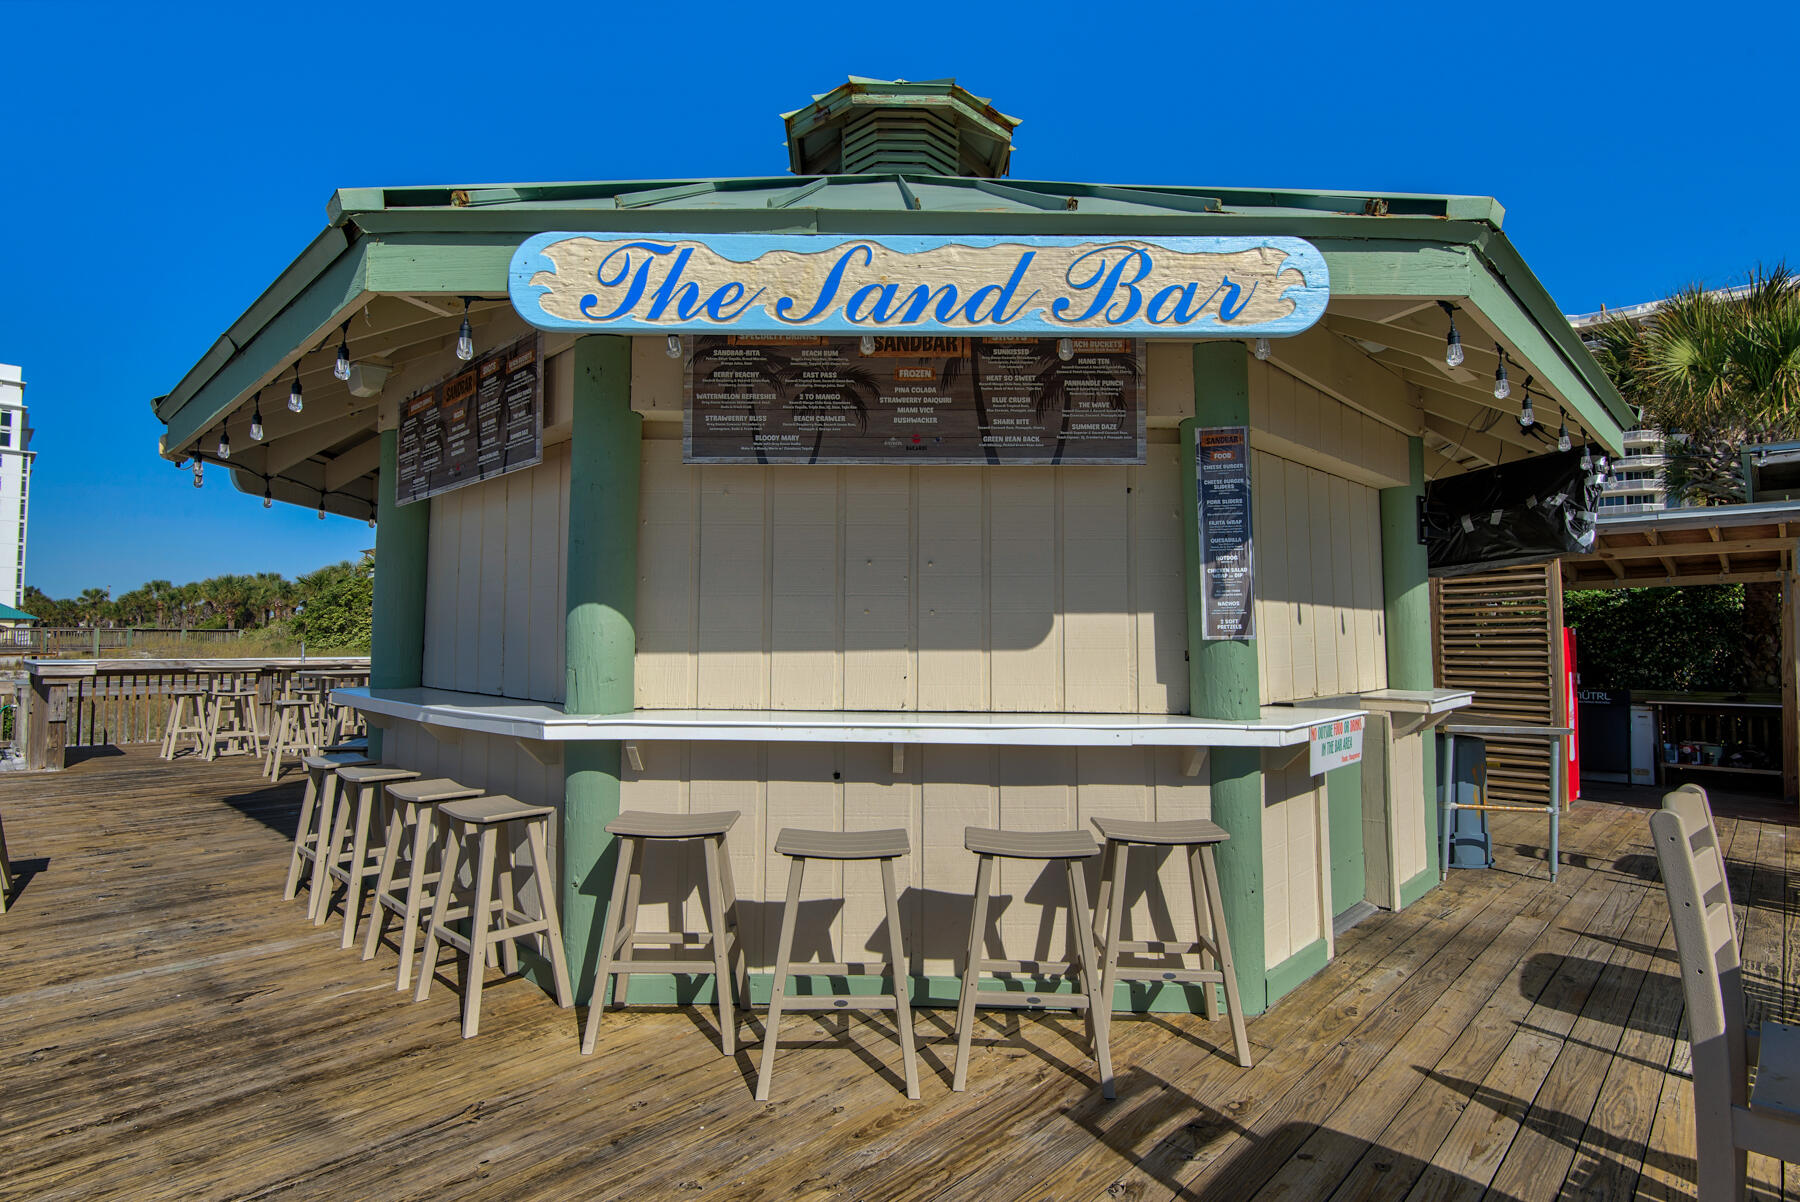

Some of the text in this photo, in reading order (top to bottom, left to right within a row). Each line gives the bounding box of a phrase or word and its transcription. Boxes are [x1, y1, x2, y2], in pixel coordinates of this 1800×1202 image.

[580, 242, 1258, 324] The Sand Bar
[873, 336, 958, 352] SANDBAR
[1090, 340, 1122, 348] BUCKETS
[899, 369, 932, 378] FROZEN
[446, 376, 473, 402] SANDBAR
[1206, 436, 1239, 444] SANDBAR
[1318, 724, 1333, 740] OUTSIDE
[1334, 720, 1343, 736] FOOD
[1344, 720, 1349, 734] OR
[1321, 742, 1326, 757] IN
[1334, 738, 1342, 752] BAR
[1343, 736, 1353, 750] AREA
